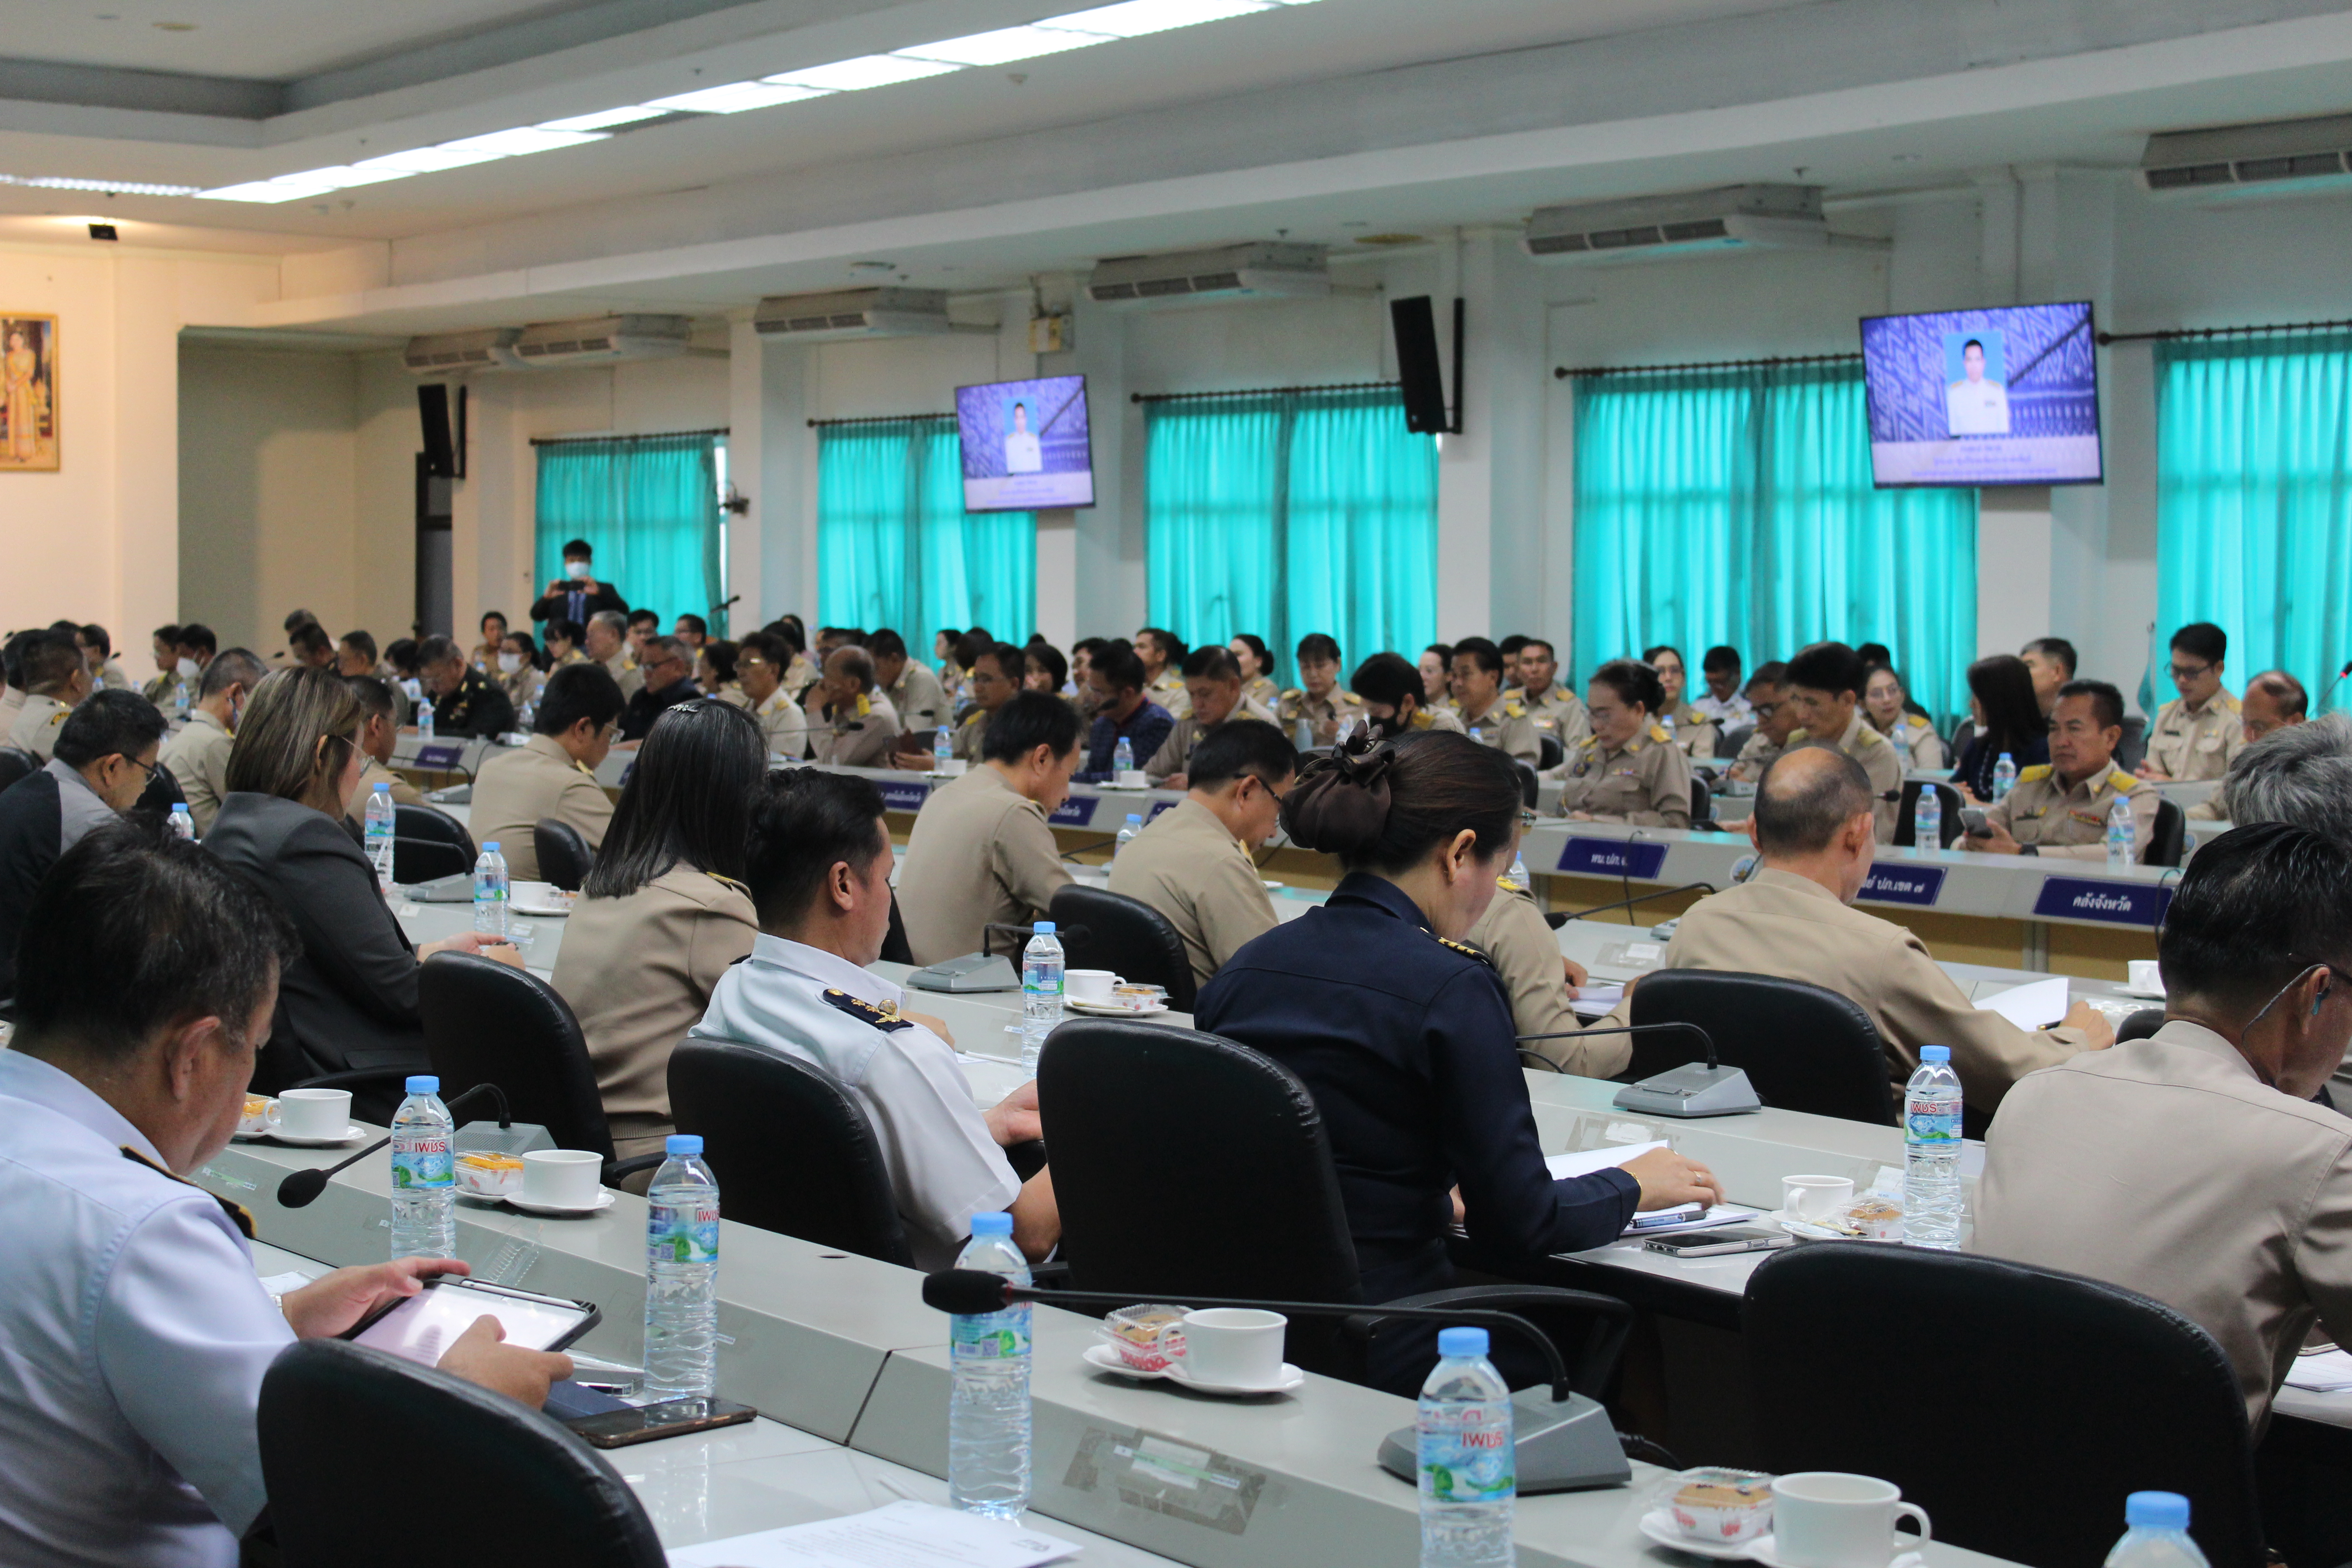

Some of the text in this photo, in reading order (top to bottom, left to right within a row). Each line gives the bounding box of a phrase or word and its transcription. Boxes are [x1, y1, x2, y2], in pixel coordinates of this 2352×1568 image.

[2073, 892, 2132, 912] คลังจังหวัด
